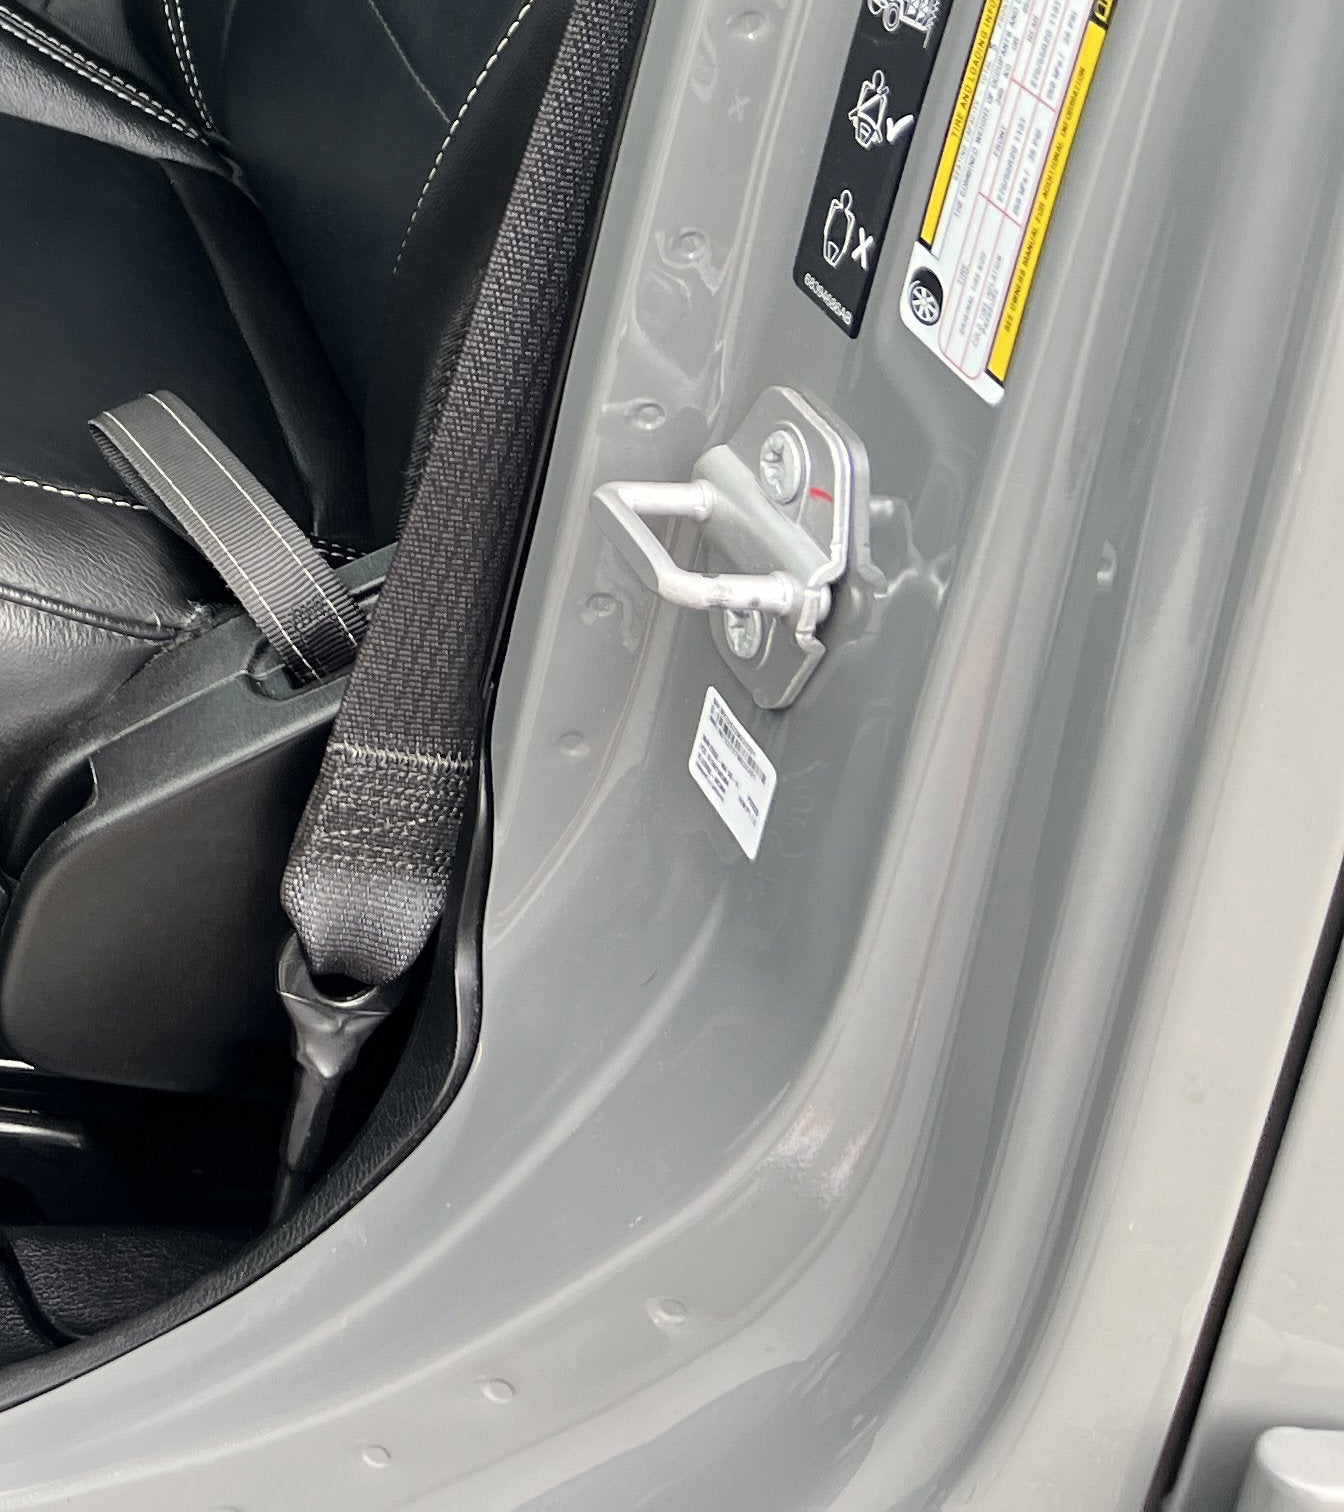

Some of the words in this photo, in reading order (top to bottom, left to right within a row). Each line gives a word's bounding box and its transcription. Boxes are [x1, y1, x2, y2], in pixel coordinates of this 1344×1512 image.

[951, 112, 963, 139] TIRE
[959, 83, 971, 110] AND
[967, 28, 987, 83] LOADING
